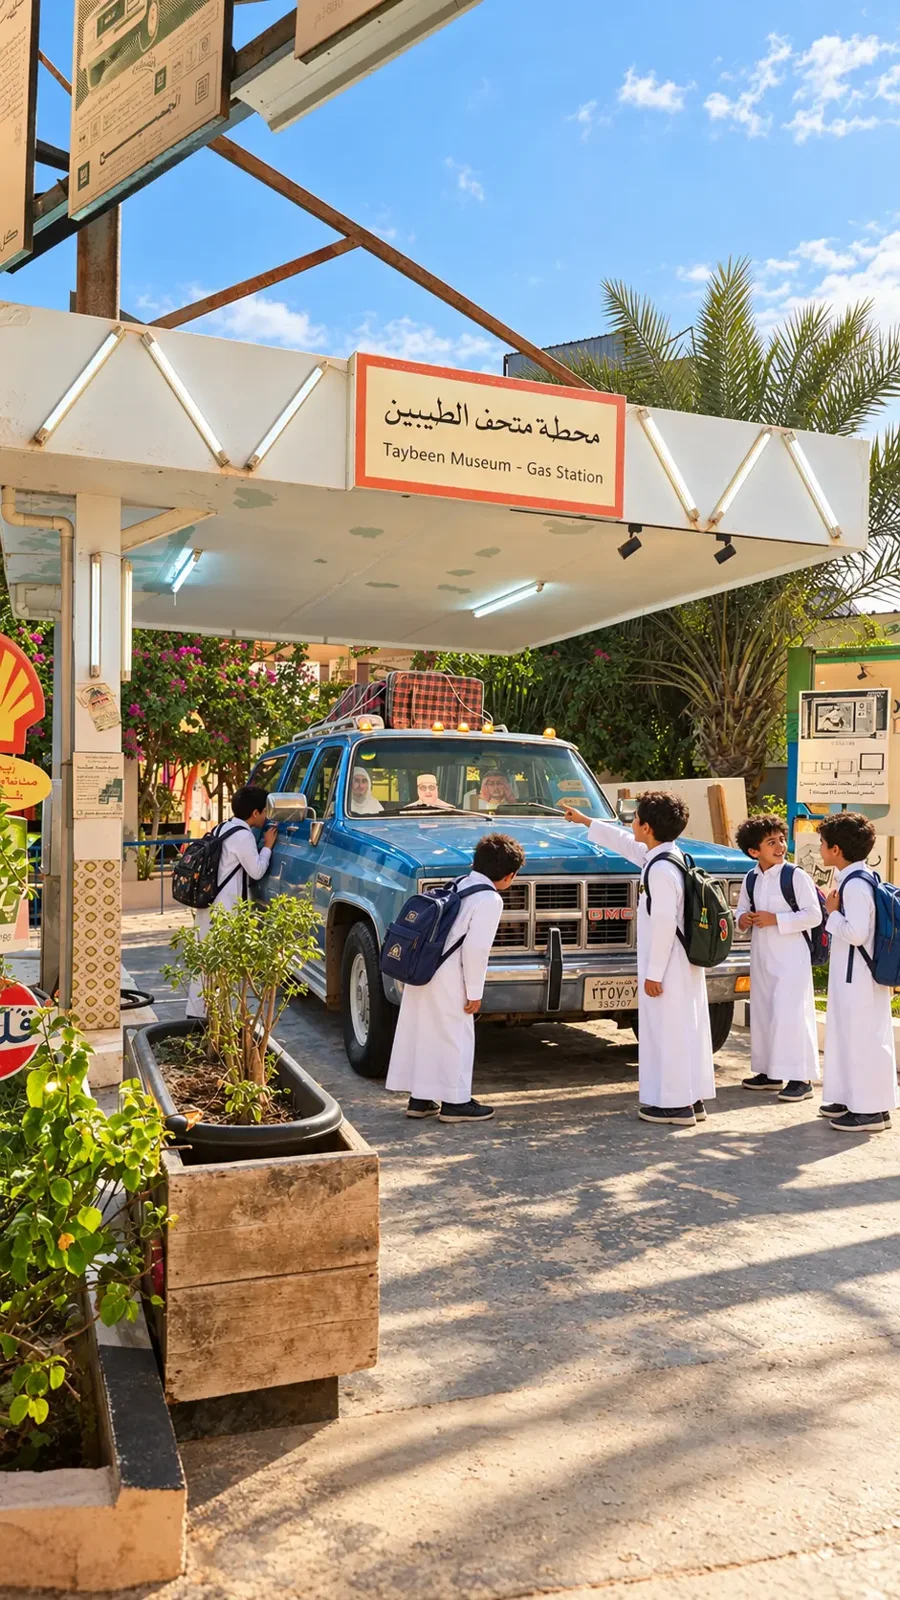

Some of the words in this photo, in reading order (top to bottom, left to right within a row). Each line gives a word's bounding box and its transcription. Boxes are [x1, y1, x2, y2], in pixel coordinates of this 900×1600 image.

[384, 397, 469, 431] الطيبين
[475, 408, 533, 435] متحف
[536, 415, 600, 445] محطة
[383, 442, 446, 463] Taybeen
[450, 452, 512, 473] Museum
[527, 462, 552, 478] Gas
[556, 466, 604, 484] Station
